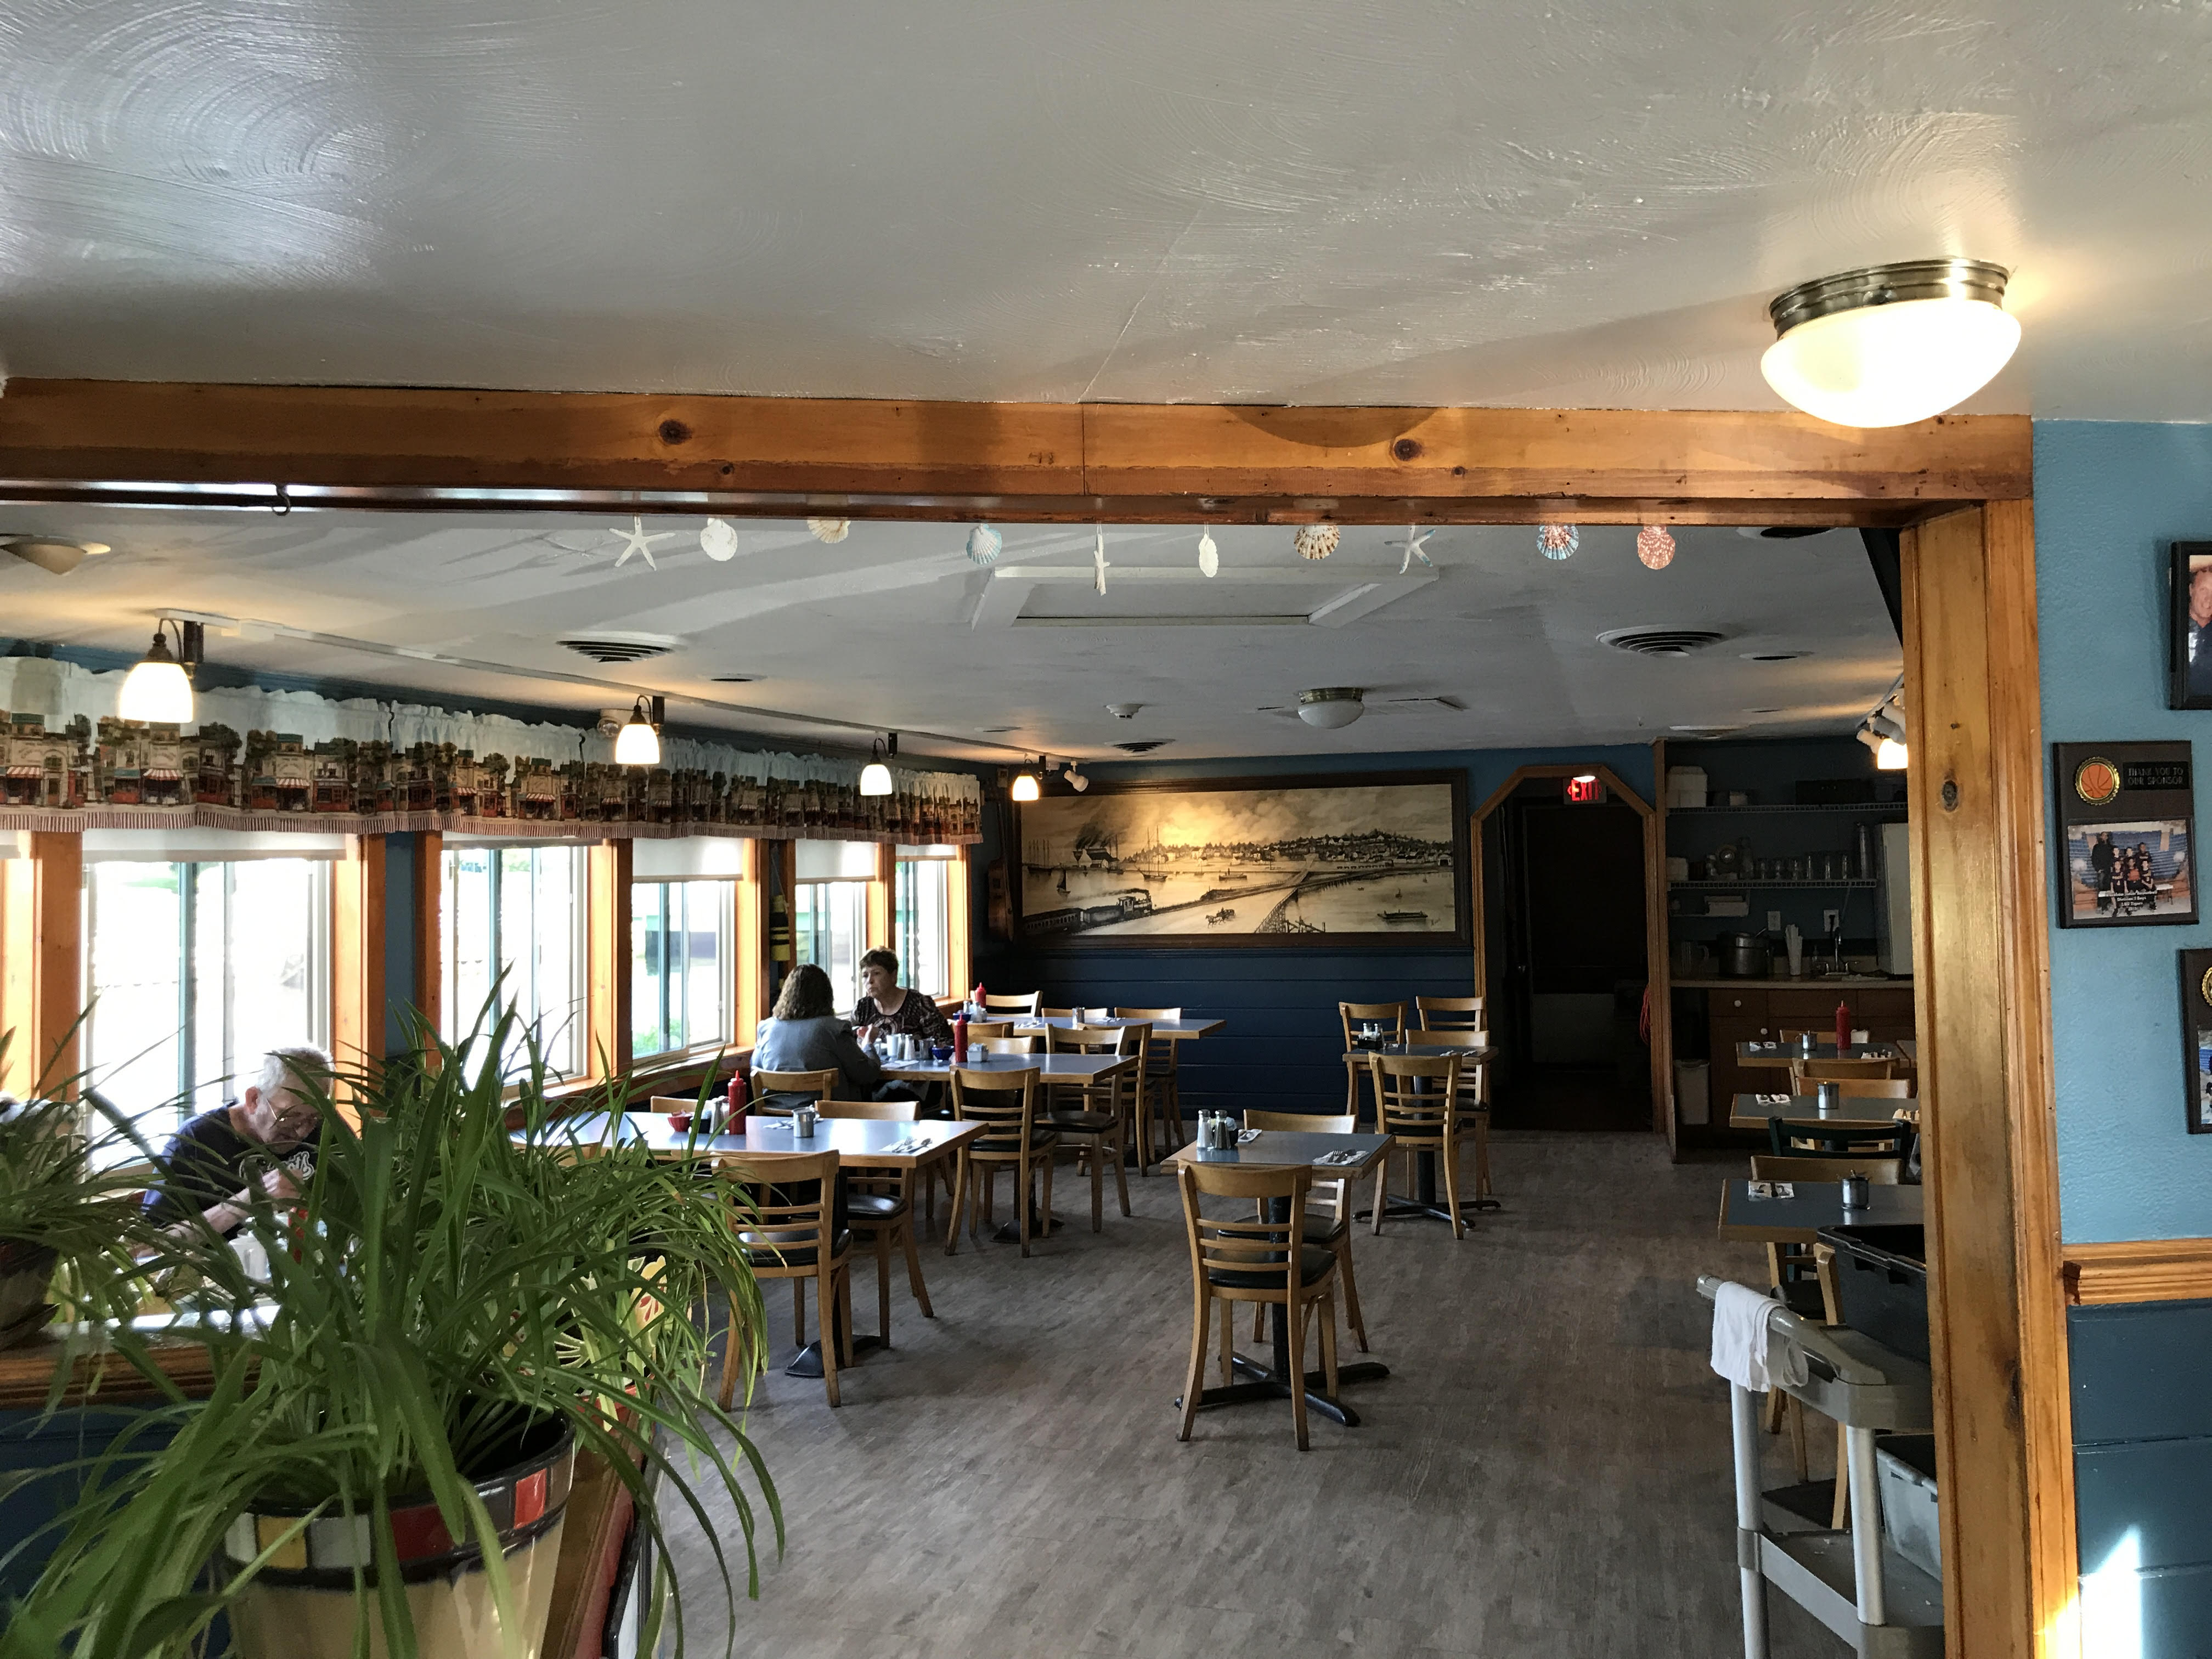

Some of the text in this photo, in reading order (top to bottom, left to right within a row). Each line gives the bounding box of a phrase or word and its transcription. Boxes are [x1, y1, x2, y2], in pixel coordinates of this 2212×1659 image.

[2128, 767, 2184, 776] THANK YOU TO
[2128, 776, 2183, 786] OUR SPONSOR
[1571, 779, 1599, 802] EXIT
